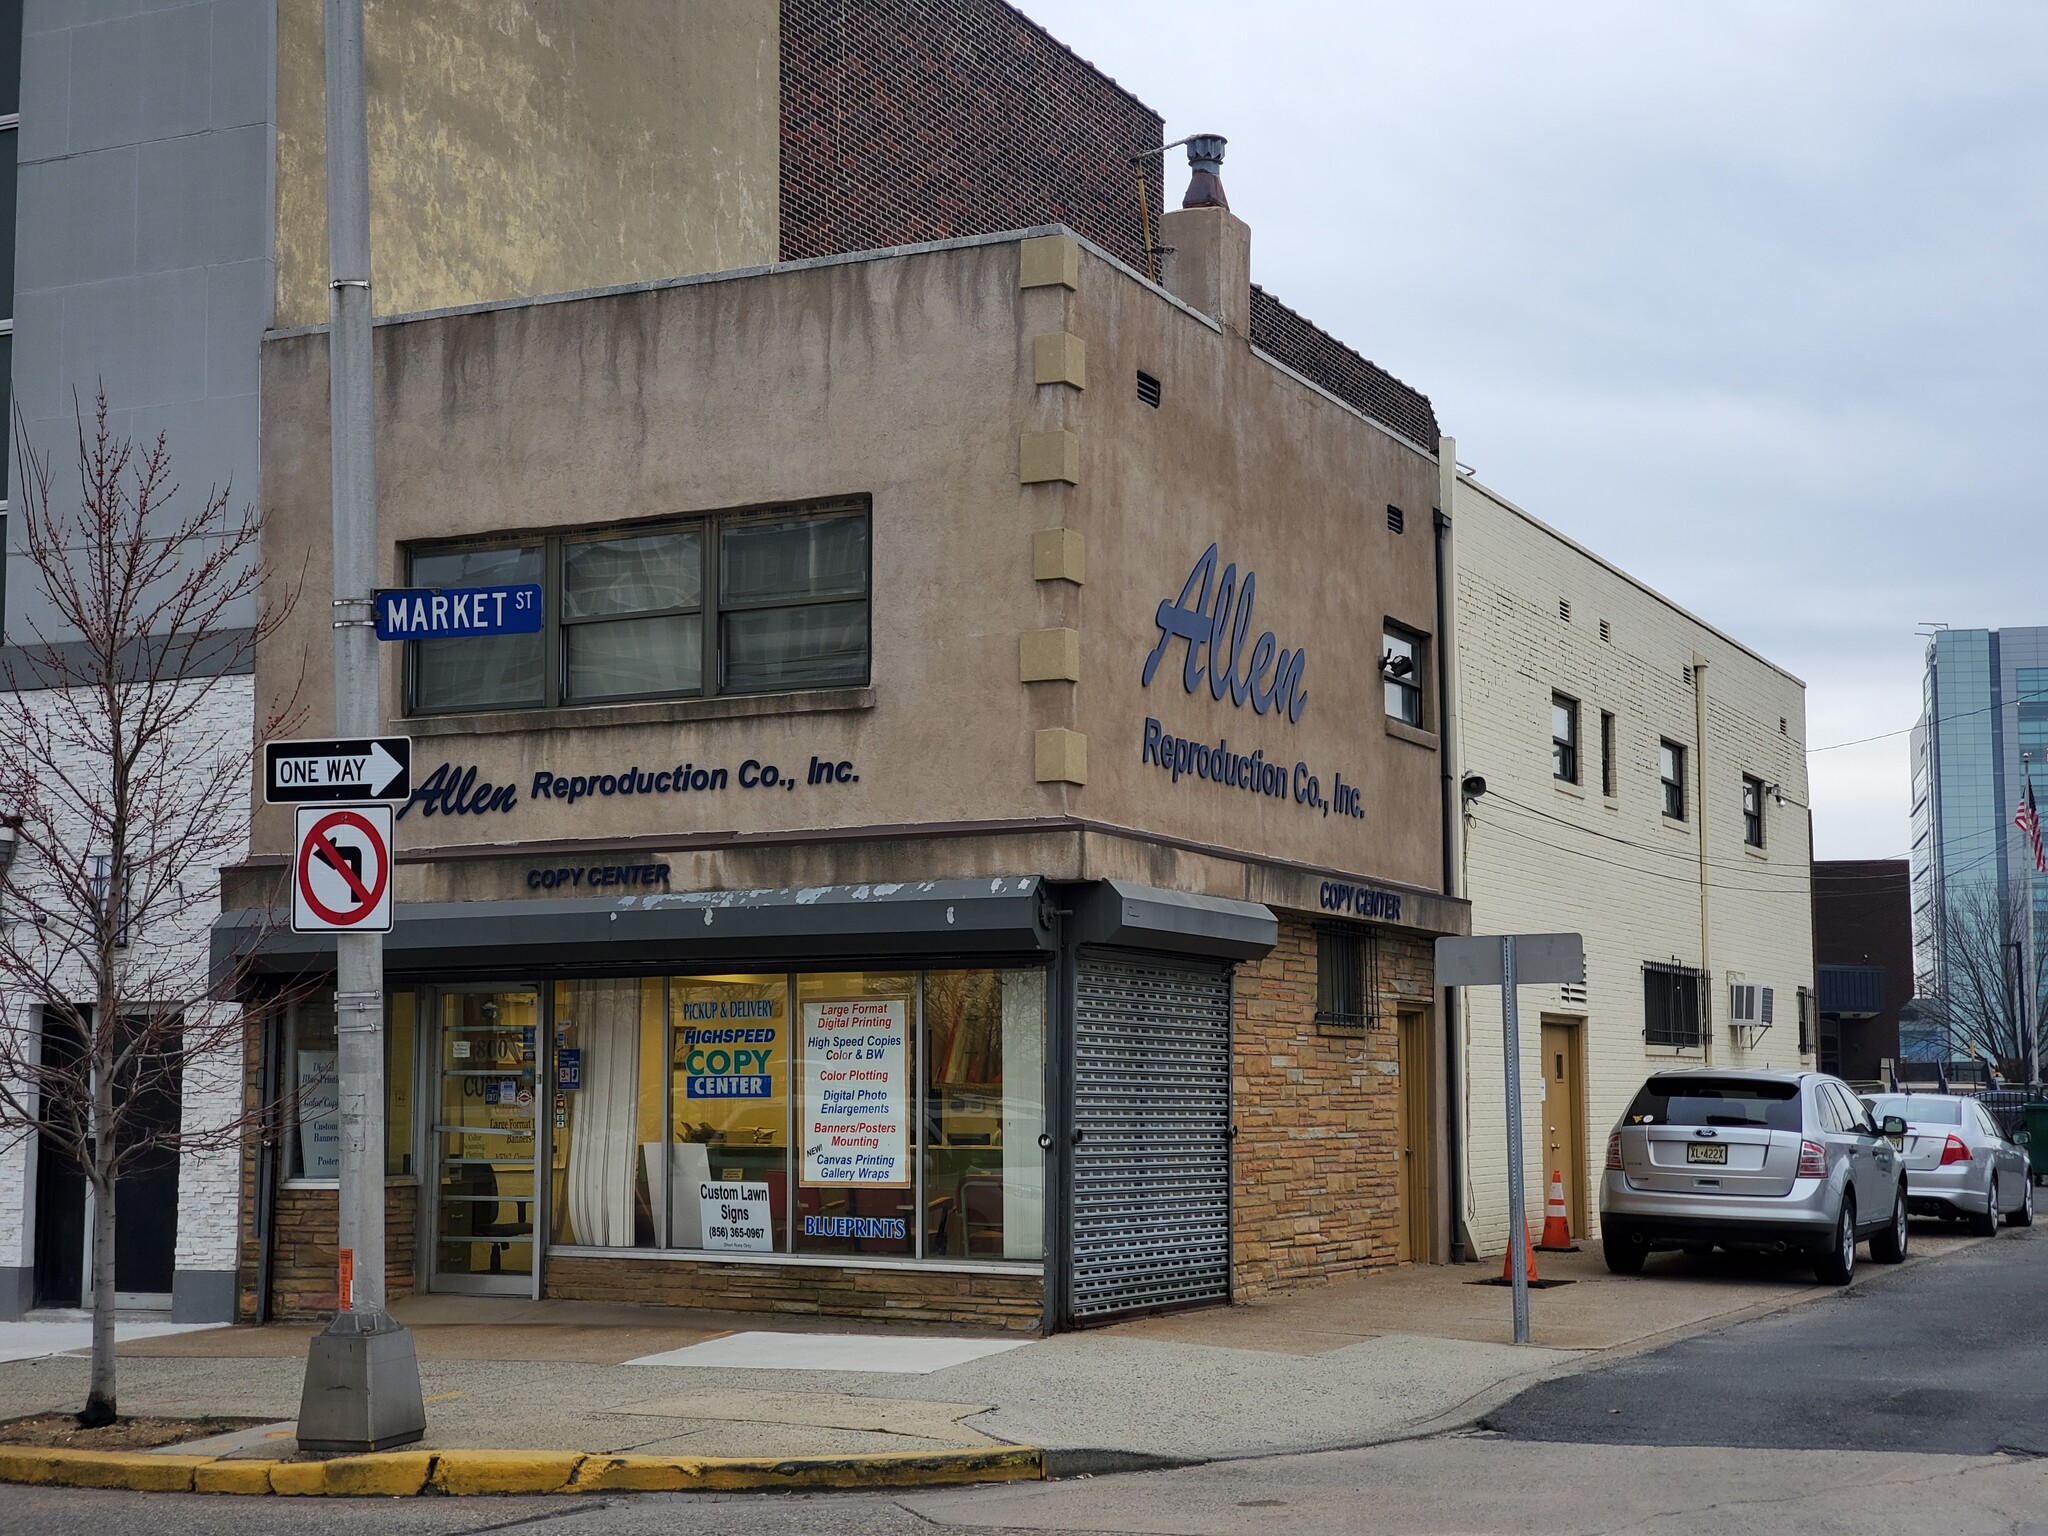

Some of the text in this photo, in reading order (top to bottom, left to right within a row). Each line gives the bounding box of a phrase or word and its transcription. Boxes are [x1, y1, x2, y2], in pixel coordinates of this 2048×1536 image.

[388, 591, 533, 633] MARKET ST
[1141, 542, 1308, 724] Allen
[280, 758, 367, 784] ONE WAY
[1142, 716, 1366, 819] Reproduction Co., Inc.
[396, 756, 861, 821] Allen Reproduction Co., Inc.
[527, 862, 671, 890] COPY CENTER
[1319, 881, 1402, 921] COPY CENTER
[683, 998, 774, 1021] PICKUP & DELIVERY
[821, 1003, 888, 1017] Large Format
[818, 1017, 892, 1031] Digital Printing
[684, 1028, 776, 1045] HIGHSPEED
[808, 1035, 902, 1050] High Speed Copies
[475, 1039, 508, 1059] 800
[826, 1048, 885, 1061] Color & BW
[685, 1050, 773, 1075] COPY
[820, 1069, 889, 1083] Color Plotting
[694, 1077, 763, 1095] CENTER
[823, 1089, 887, 1103] Digital Photo
[821, 1103, 890, 1117] Enlargements
[313, 1120, 338, 1131] Custom
[509, 1118, 531, 1129] Format
[814, 1122, 897, 1135] Banners/Posters
[806, 1143, 824, 1158] NEW!
[831, 1135, 880, 1150] Mounting
[817, 1154, 895, 1168] Canvas Printing
[821, 1167, 890, 1181] Gallery Wraps
[700, 1183, 768, 1202] Custom Lawn
[721, 1203, 750, 1225] Signs
[709, 1226, 765, 1240] (856) 365-0967
[804, 1215, 907, 1241] BLUEPRINTS
